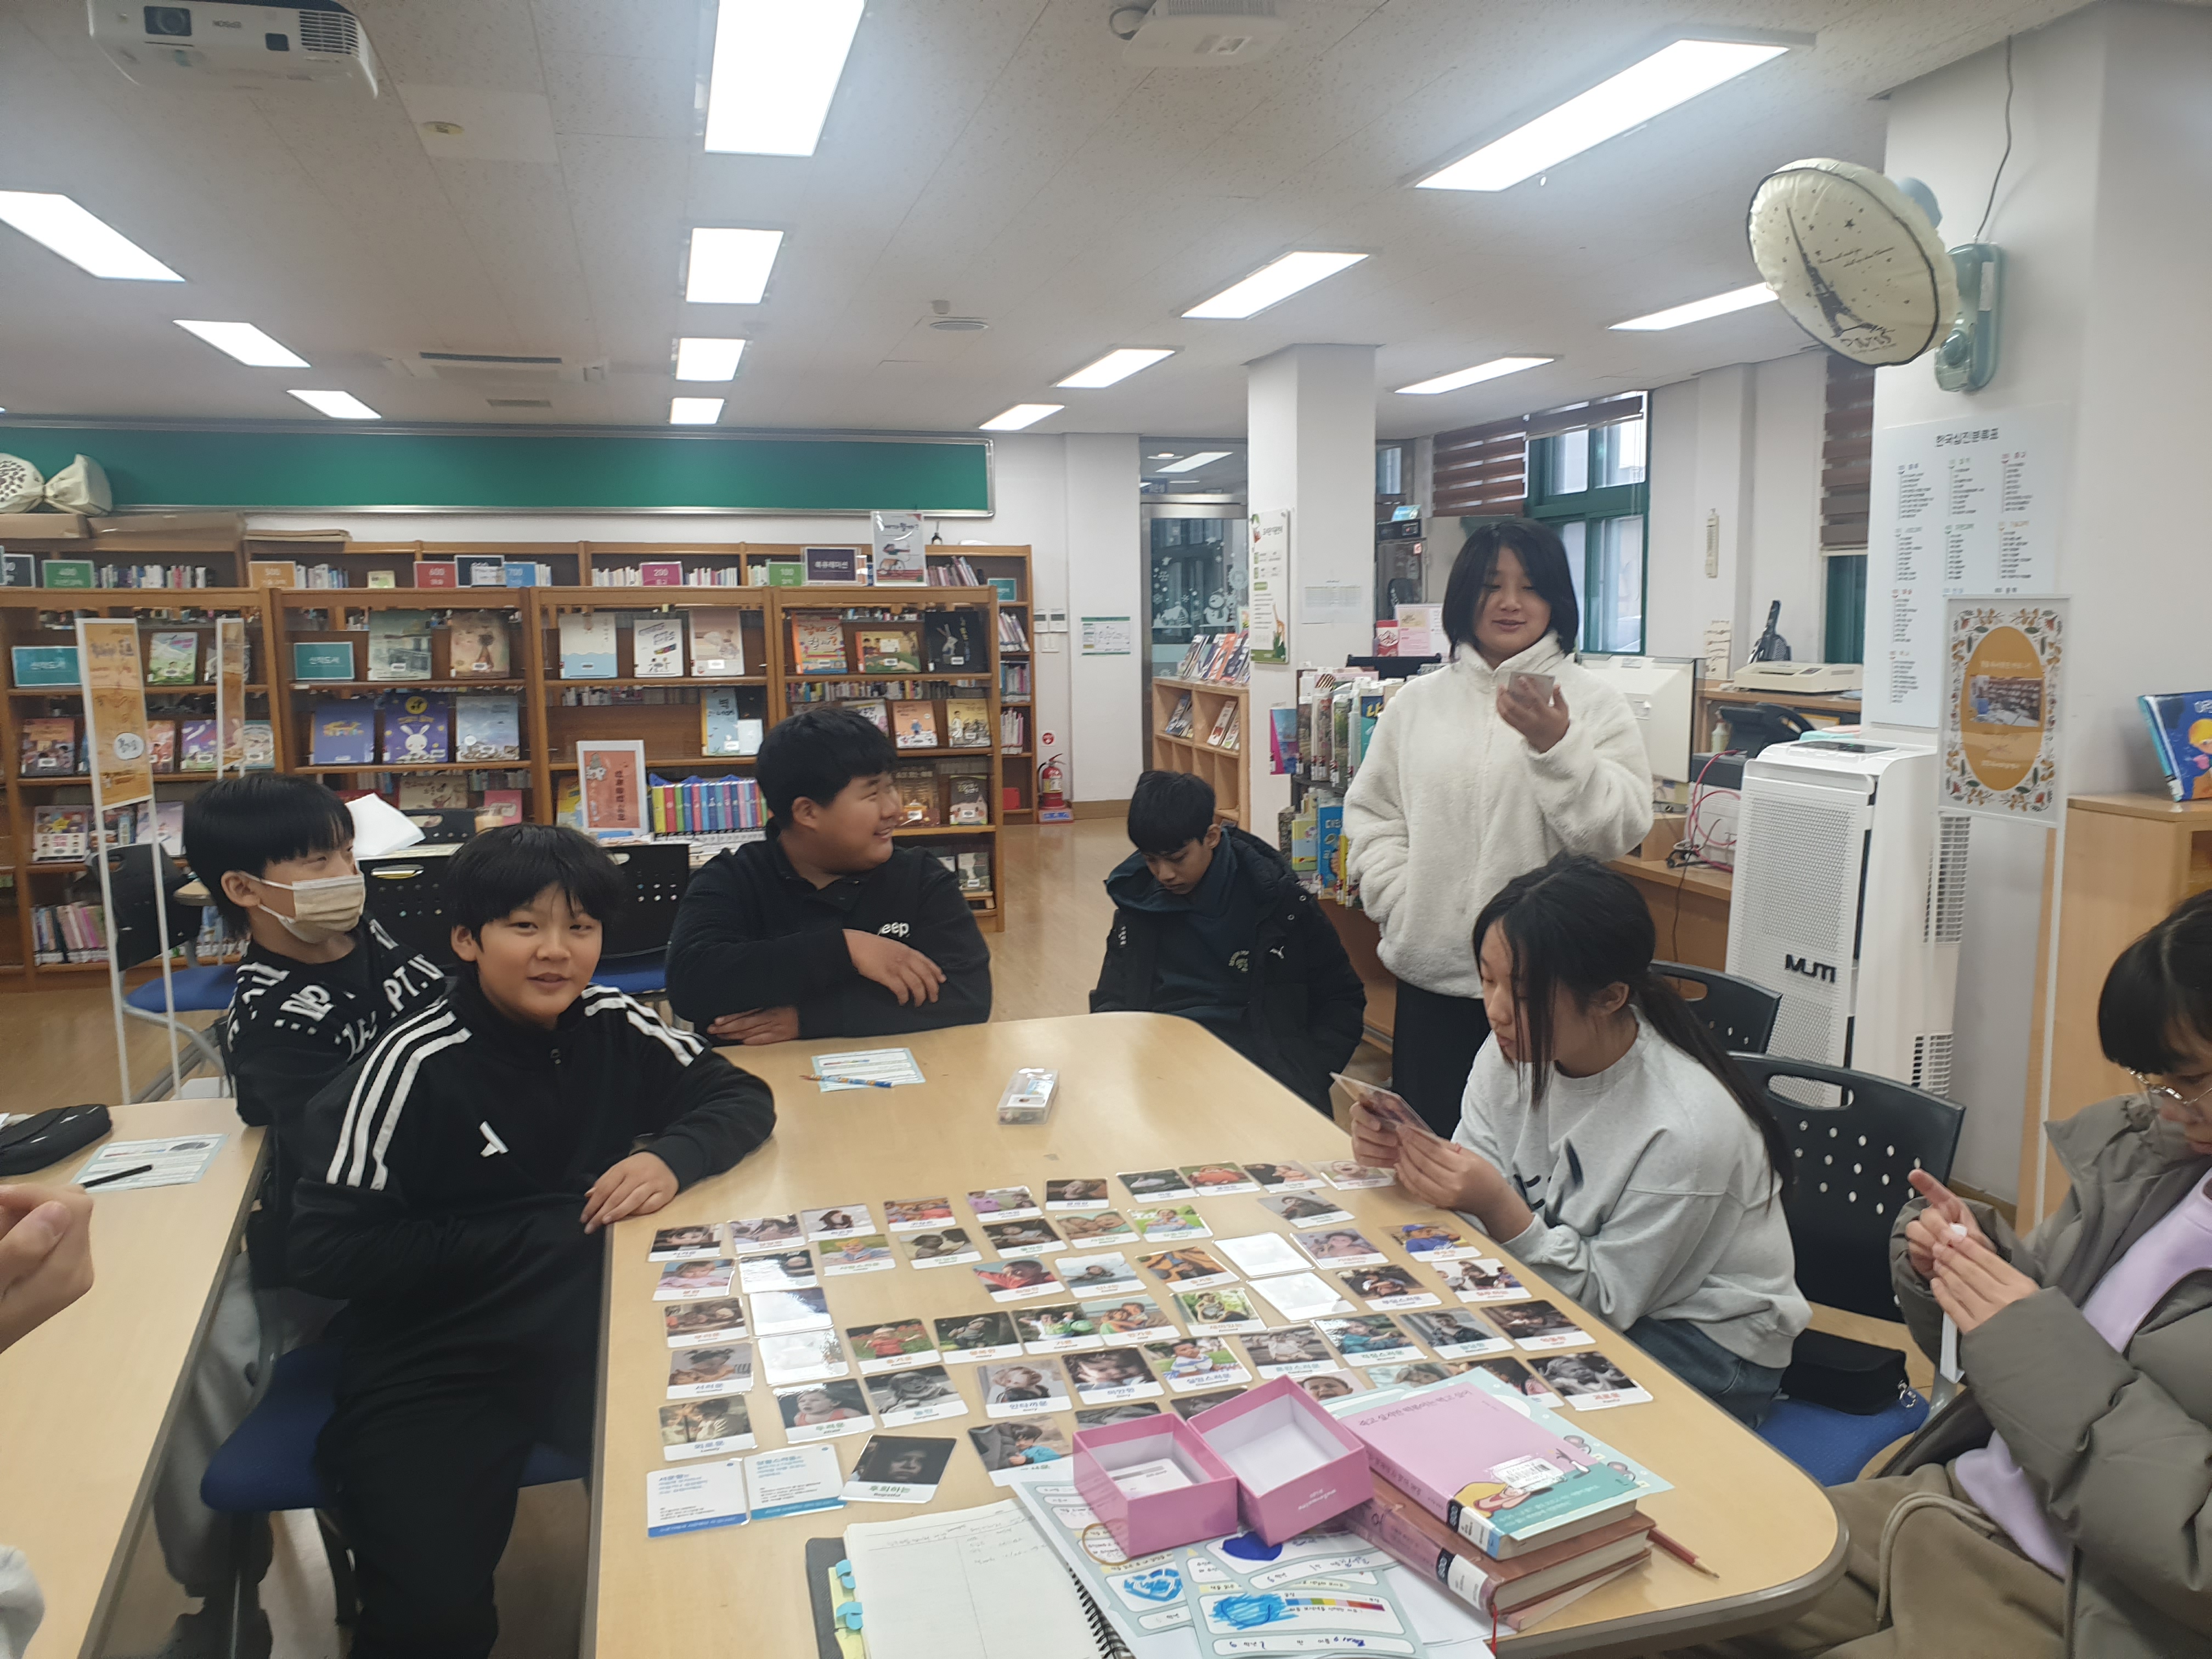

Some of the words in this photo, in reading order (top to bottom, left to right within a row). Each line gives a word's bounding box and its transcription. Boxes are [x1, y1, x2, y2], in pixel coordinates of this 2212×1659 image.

[429, 567, 445, 576] 600
[653, 568, 668, 577] 200
[1009, 1401, 1048, 1409] 안타까운
[869, 1485, 911, 1493] 후회하는
